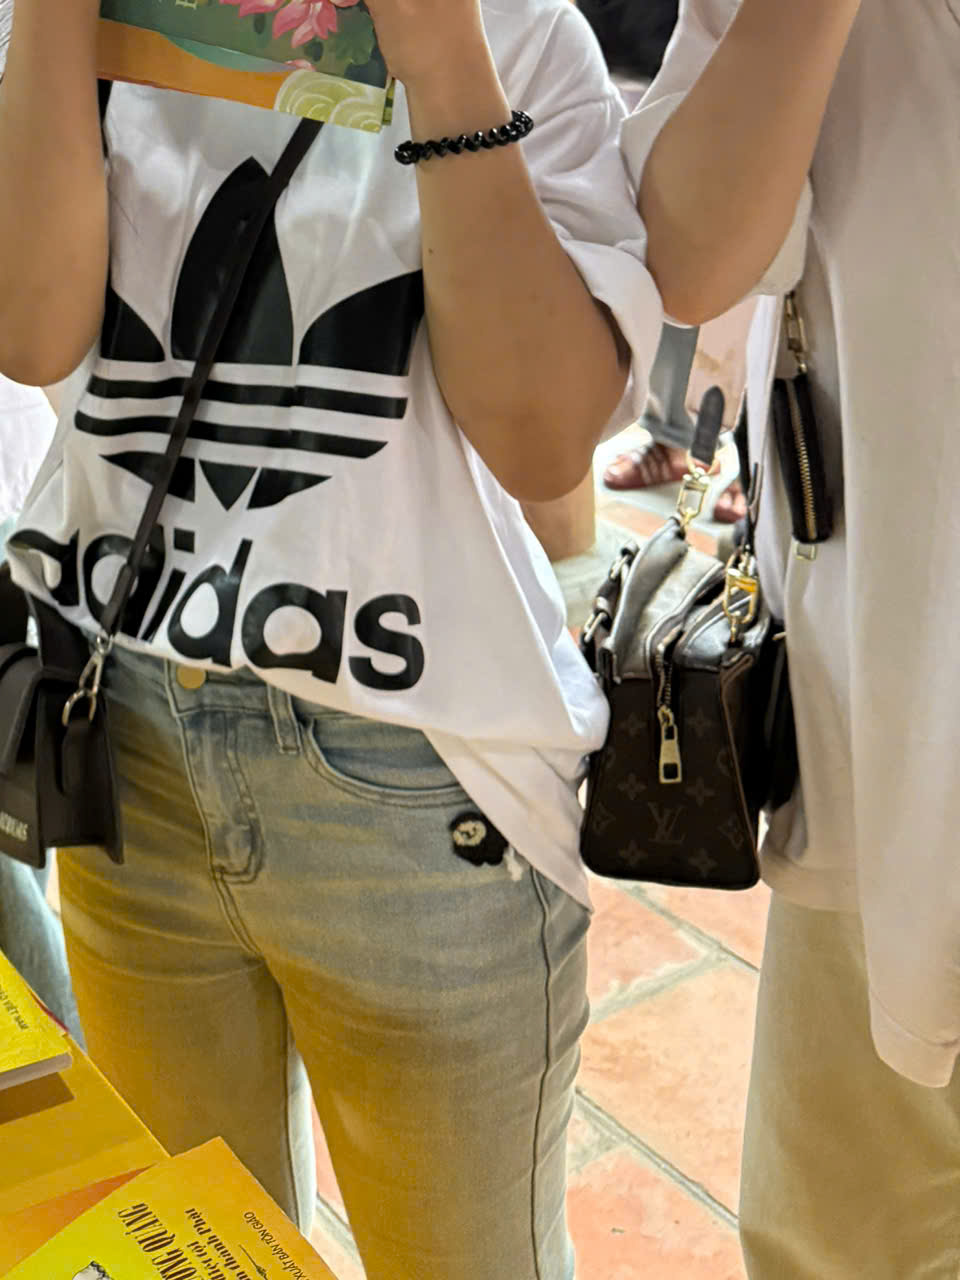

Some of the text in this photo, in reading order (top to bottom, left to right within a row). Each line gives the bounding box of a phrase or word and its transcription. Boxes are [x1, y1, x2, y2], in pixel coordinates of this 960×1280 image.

[6, 522, 426, 692] adidas
[117, 1201, 176, 1253] QUẢNG
[243, 1210, 305, 1278] XUẤT BẢN TÔN GIÁO
